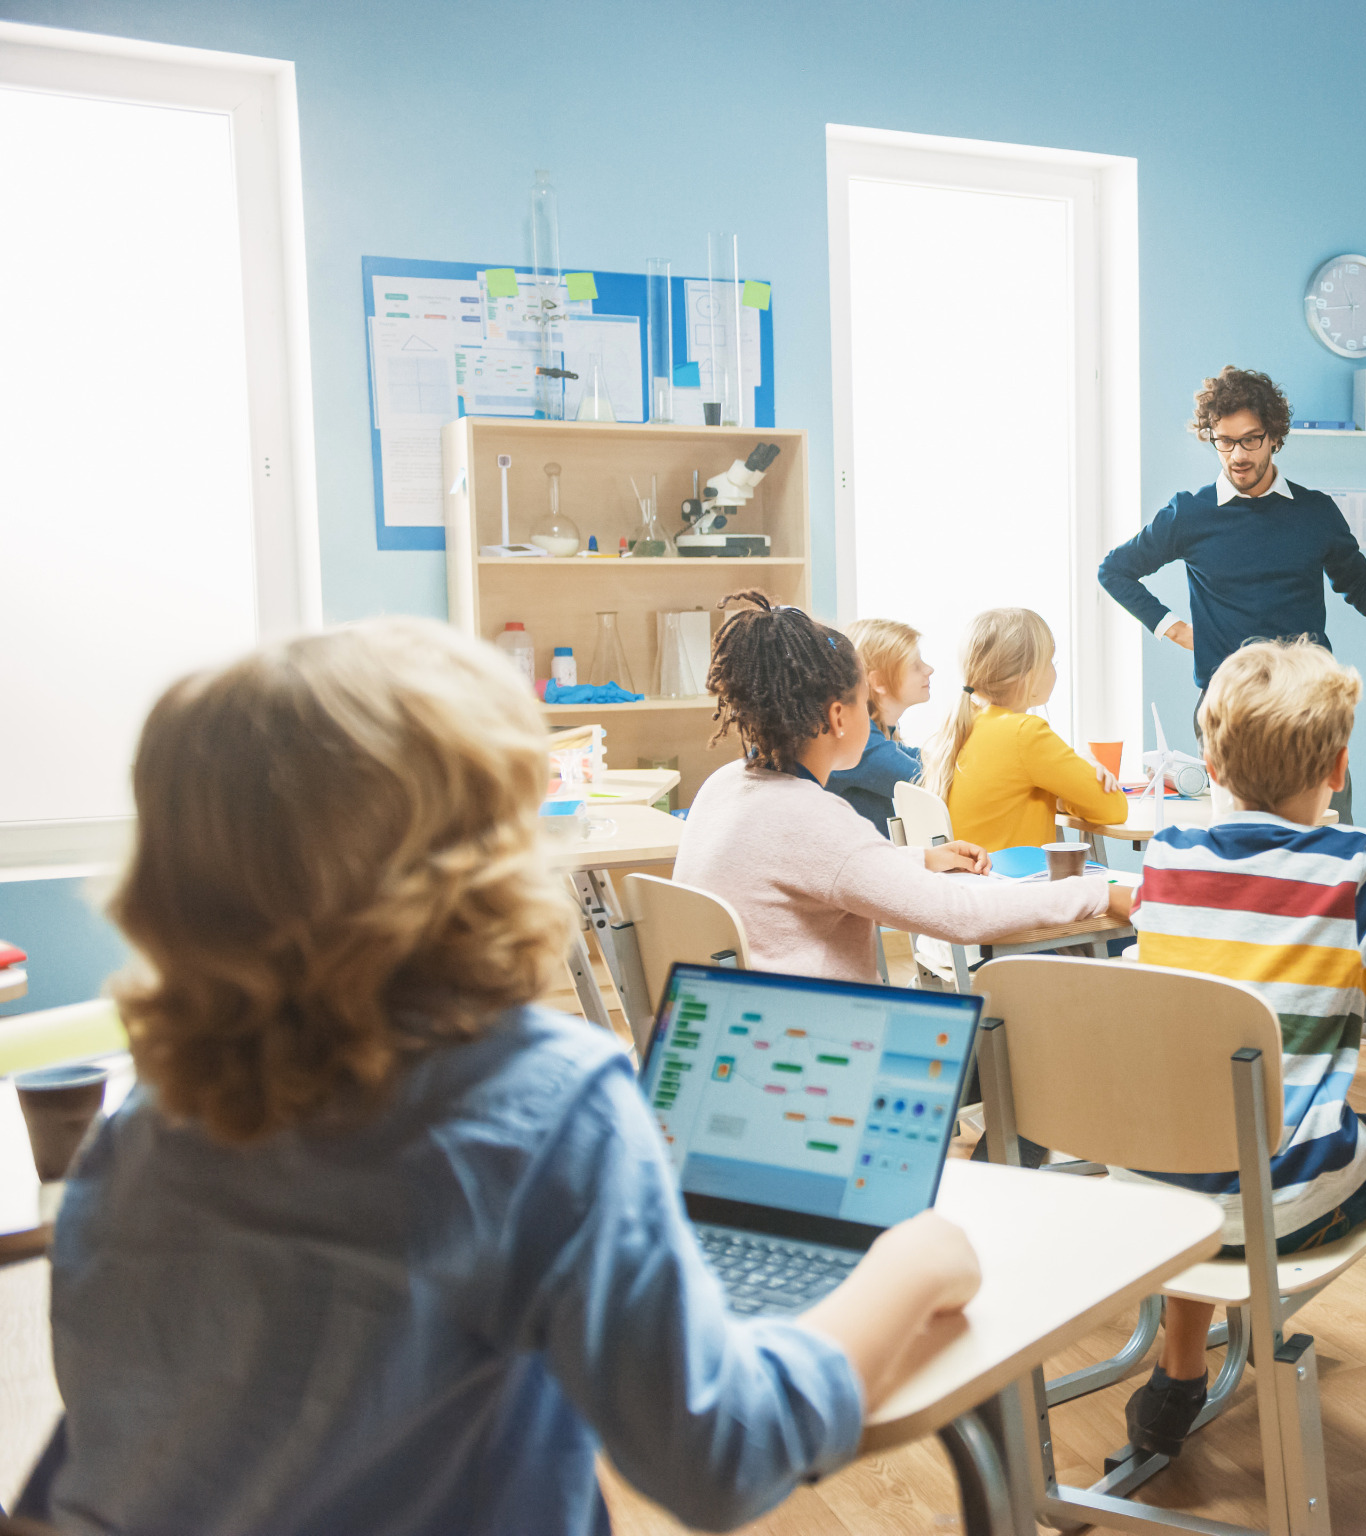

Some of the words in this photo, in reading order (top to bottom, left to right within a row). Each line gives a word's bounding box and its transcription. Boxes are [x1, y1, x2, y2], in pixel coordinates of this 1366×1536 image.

[1345, 264, 1359, 276] 12
[1320, 281, 1334, 292] 10
[1320, 317, 1331, 329] 8
[1330, 332, 1342, 343] 7
[1346, 340, 1357, 351] 6
